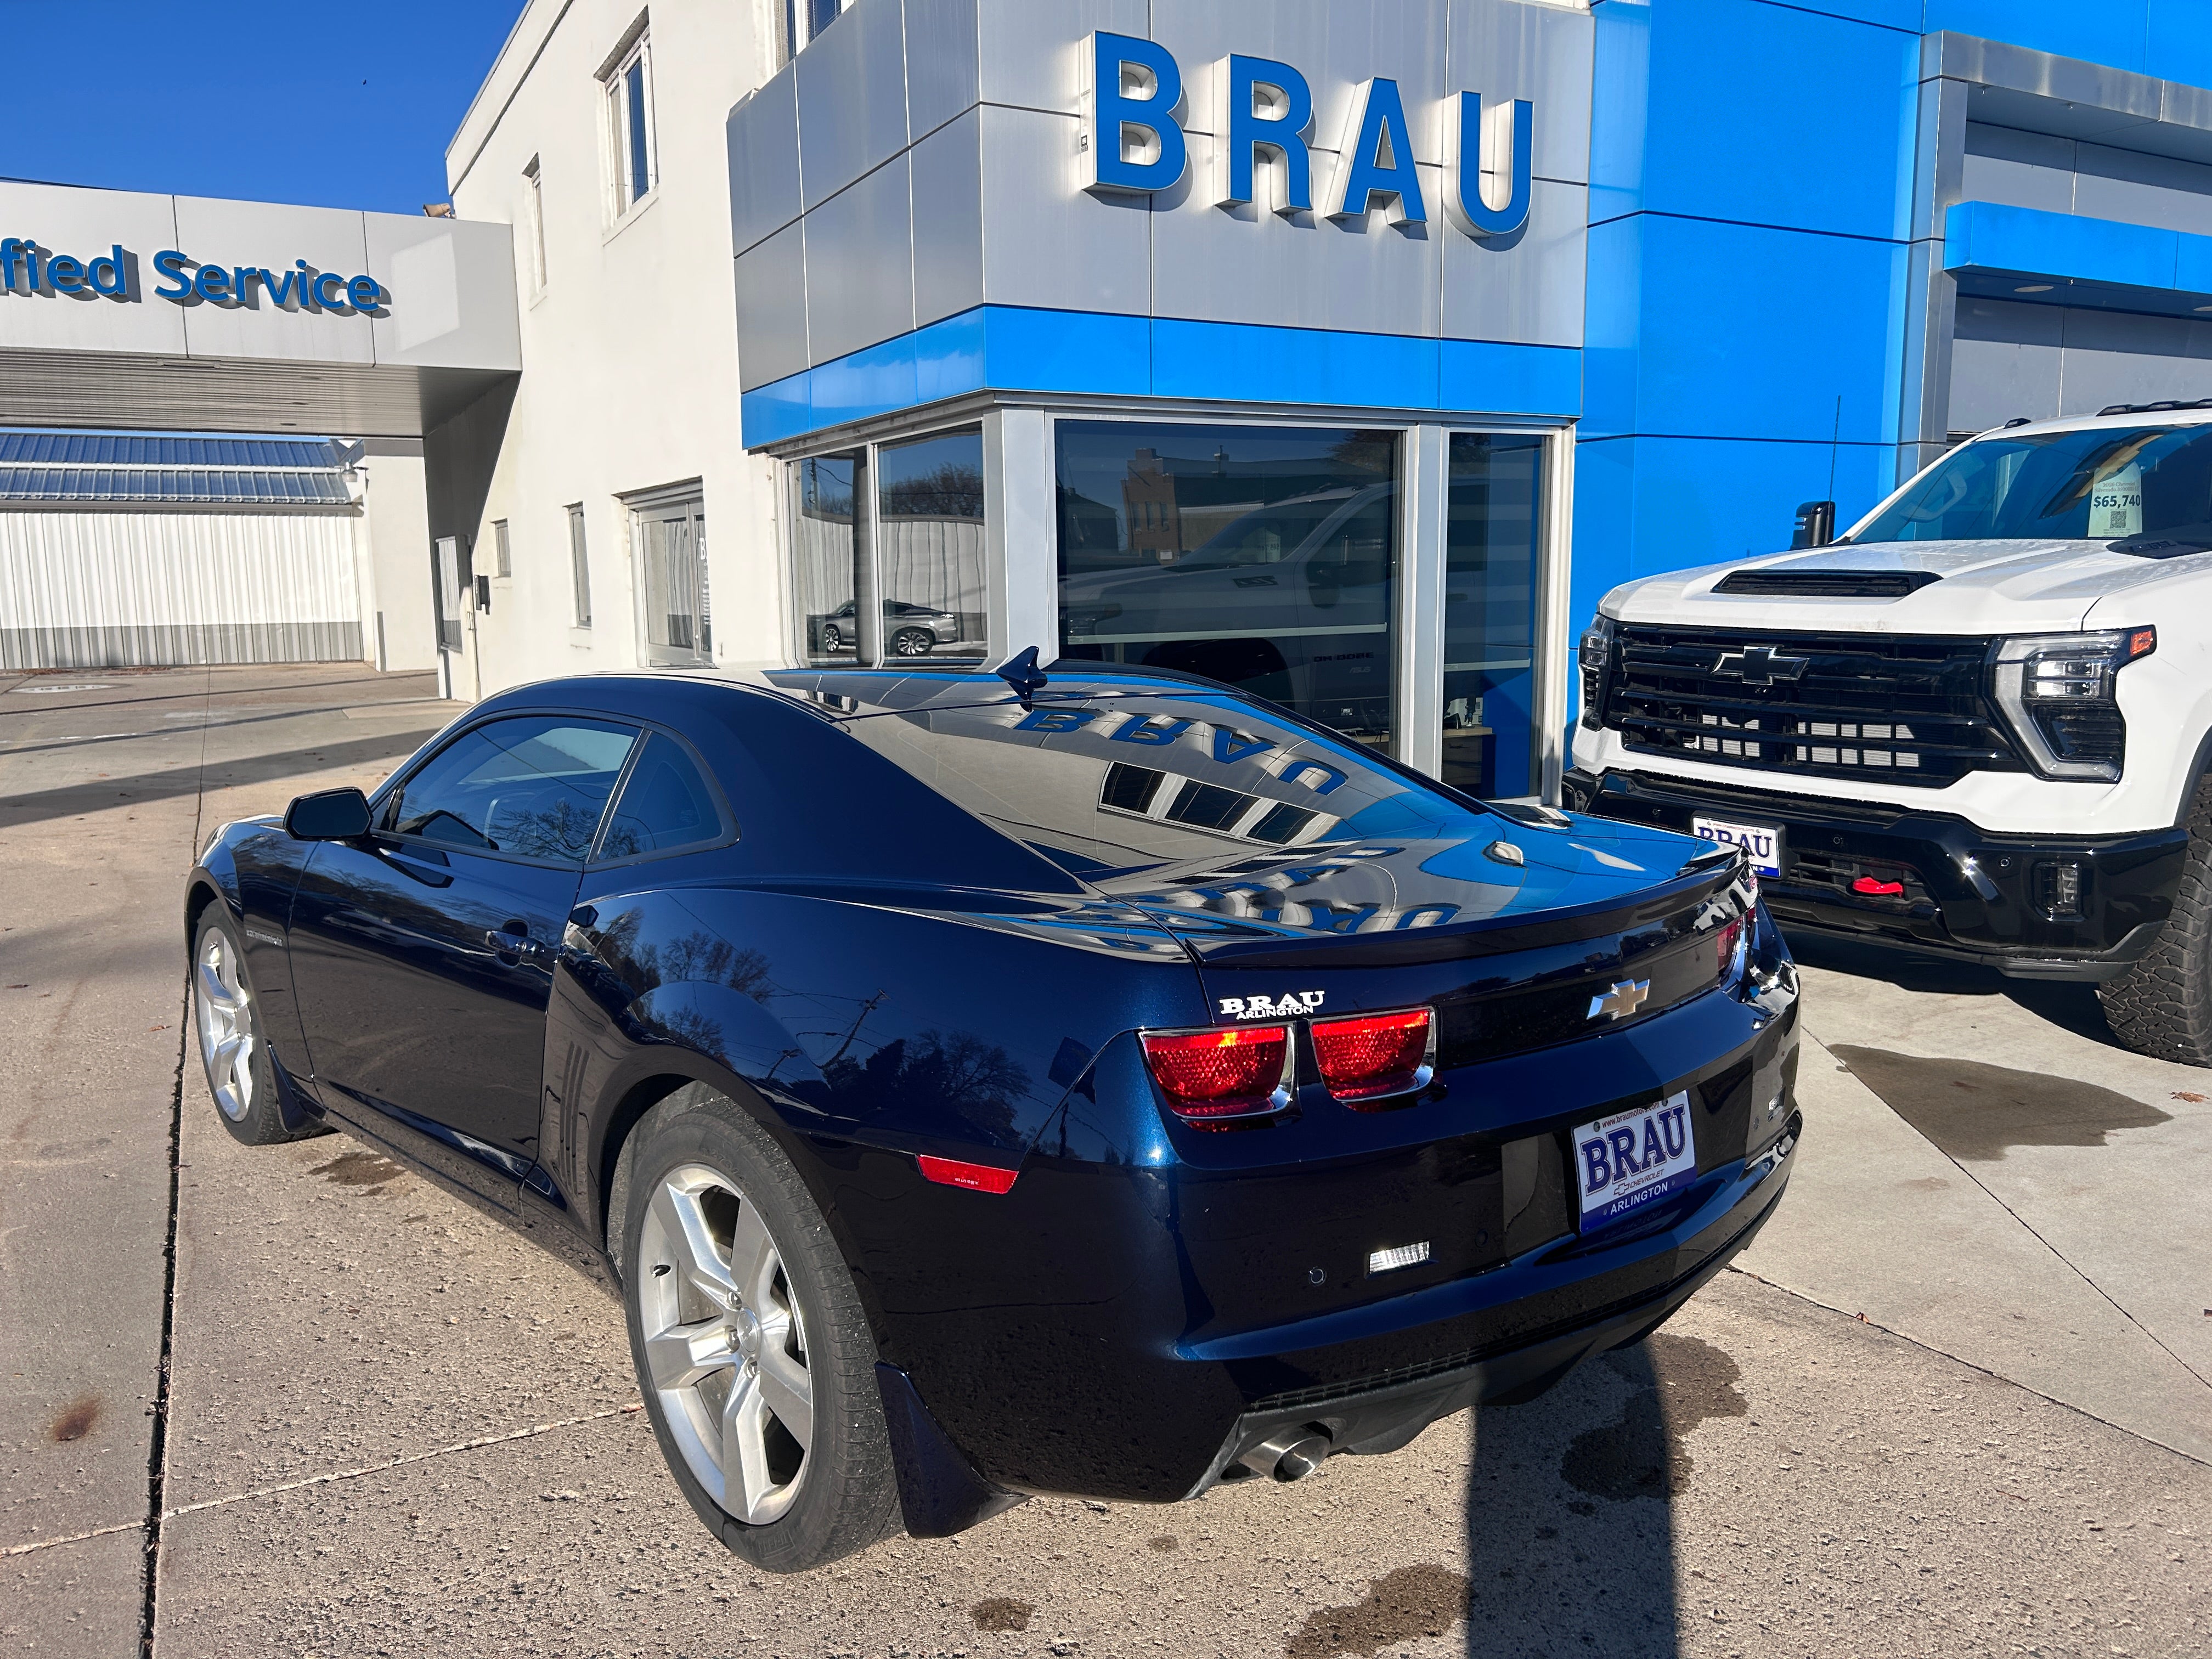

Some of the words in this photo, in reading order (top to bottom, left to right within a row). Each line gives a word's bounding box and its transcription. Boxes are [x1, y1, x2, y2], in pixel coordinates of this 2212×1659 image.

[1081, 30, 1534, 236] BRAU
[0, 238, 127, 295] fied
[153, 250, 381, 312] Service
[2094, 494, 2140, 509] $65,740
[1219, 991, 1325, 1014] BRAU
[1236, 1006, 1313, 1020] ARLINGTON
[1602, 1102, 1660, 1128] www.braumotors.com
[1580, 1104, 1685, 1197] BRAU
[1630, 1169, 1664, 1188] CHEVROLET
[1610, 1181, 1668, 1215] ARLINGTON
